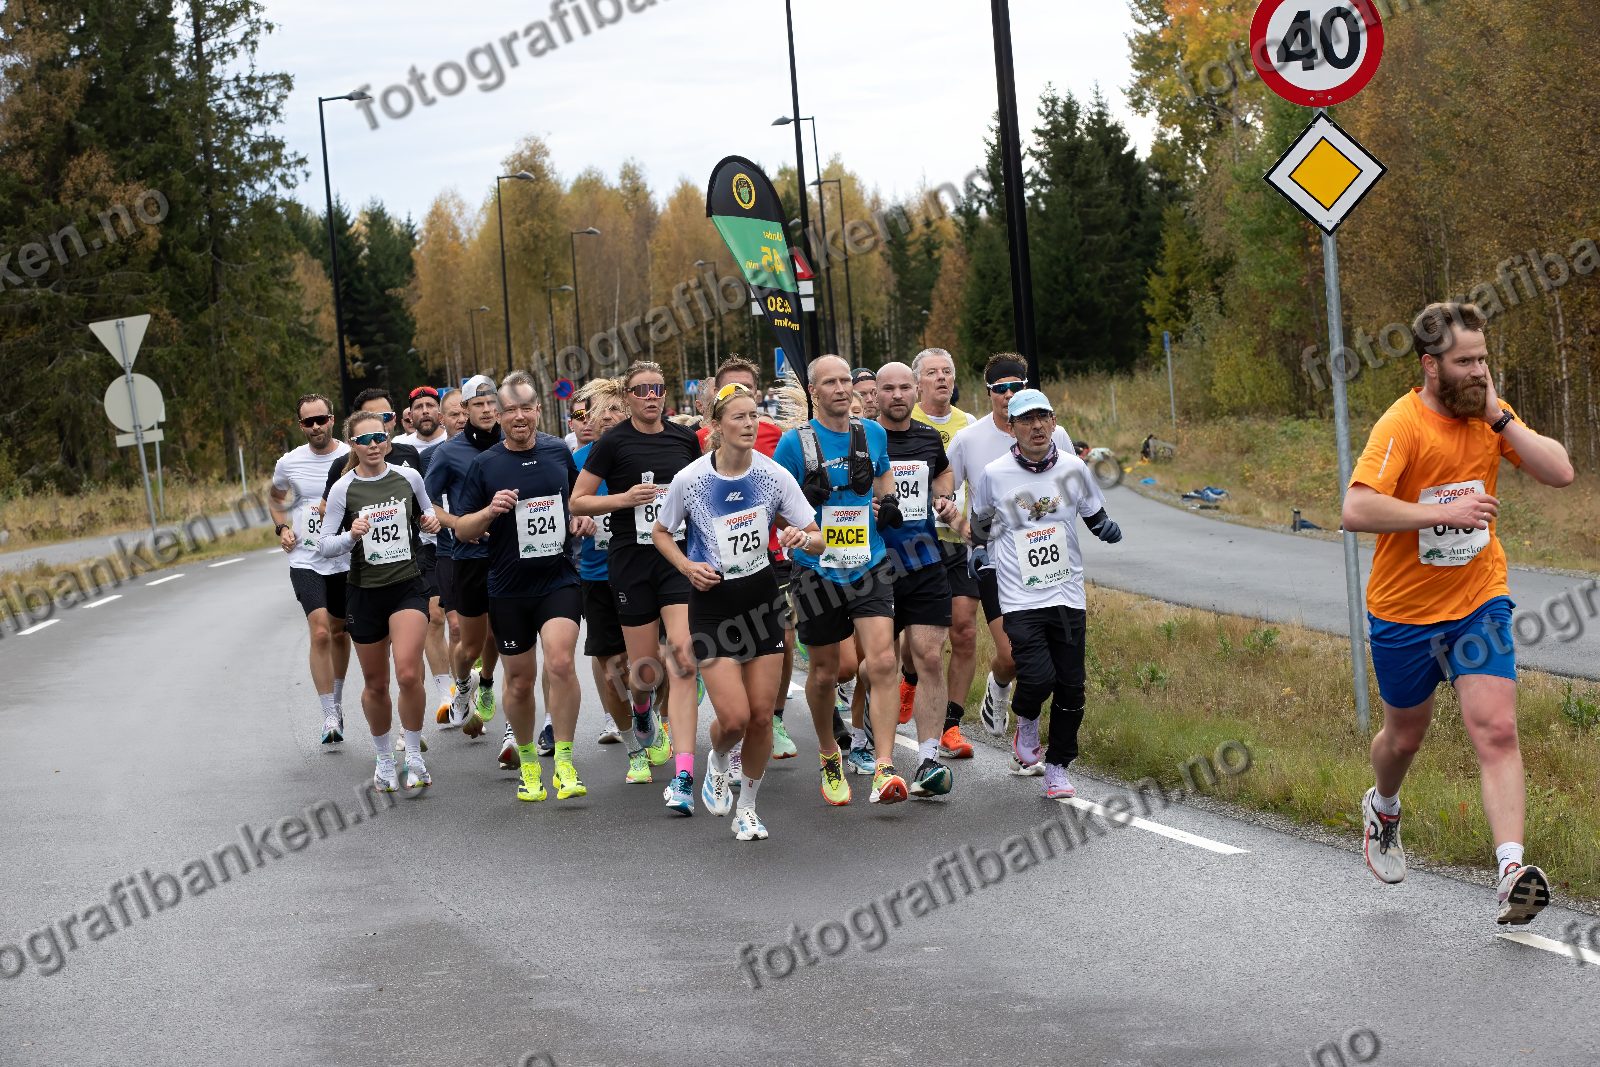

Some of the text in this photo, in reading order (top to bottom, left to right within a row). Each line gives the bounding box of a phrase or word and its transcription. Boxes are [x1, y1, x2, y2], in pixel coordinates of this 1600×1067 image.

[1277, 6, 1360, 71] 40
[1434, 487, 1475, 497] NORGES
[526, 499, 555, 508] NORGES
[529, 505, 551, 514] LØPET
[527, 515, 557, 536] 524
[726, 511, 757, 526] NORGES
[730, 518, 753, 532] LØPET
[371, 523, 401, 543] 452
[826, 528, 865, 545] PACE
[1026, 526, 1056, 539] NORGES
[1029, 533, 1052, 544] LØPET
[727, 529, 761, 556] 725
[1028, 544, 1060, 567] 628
